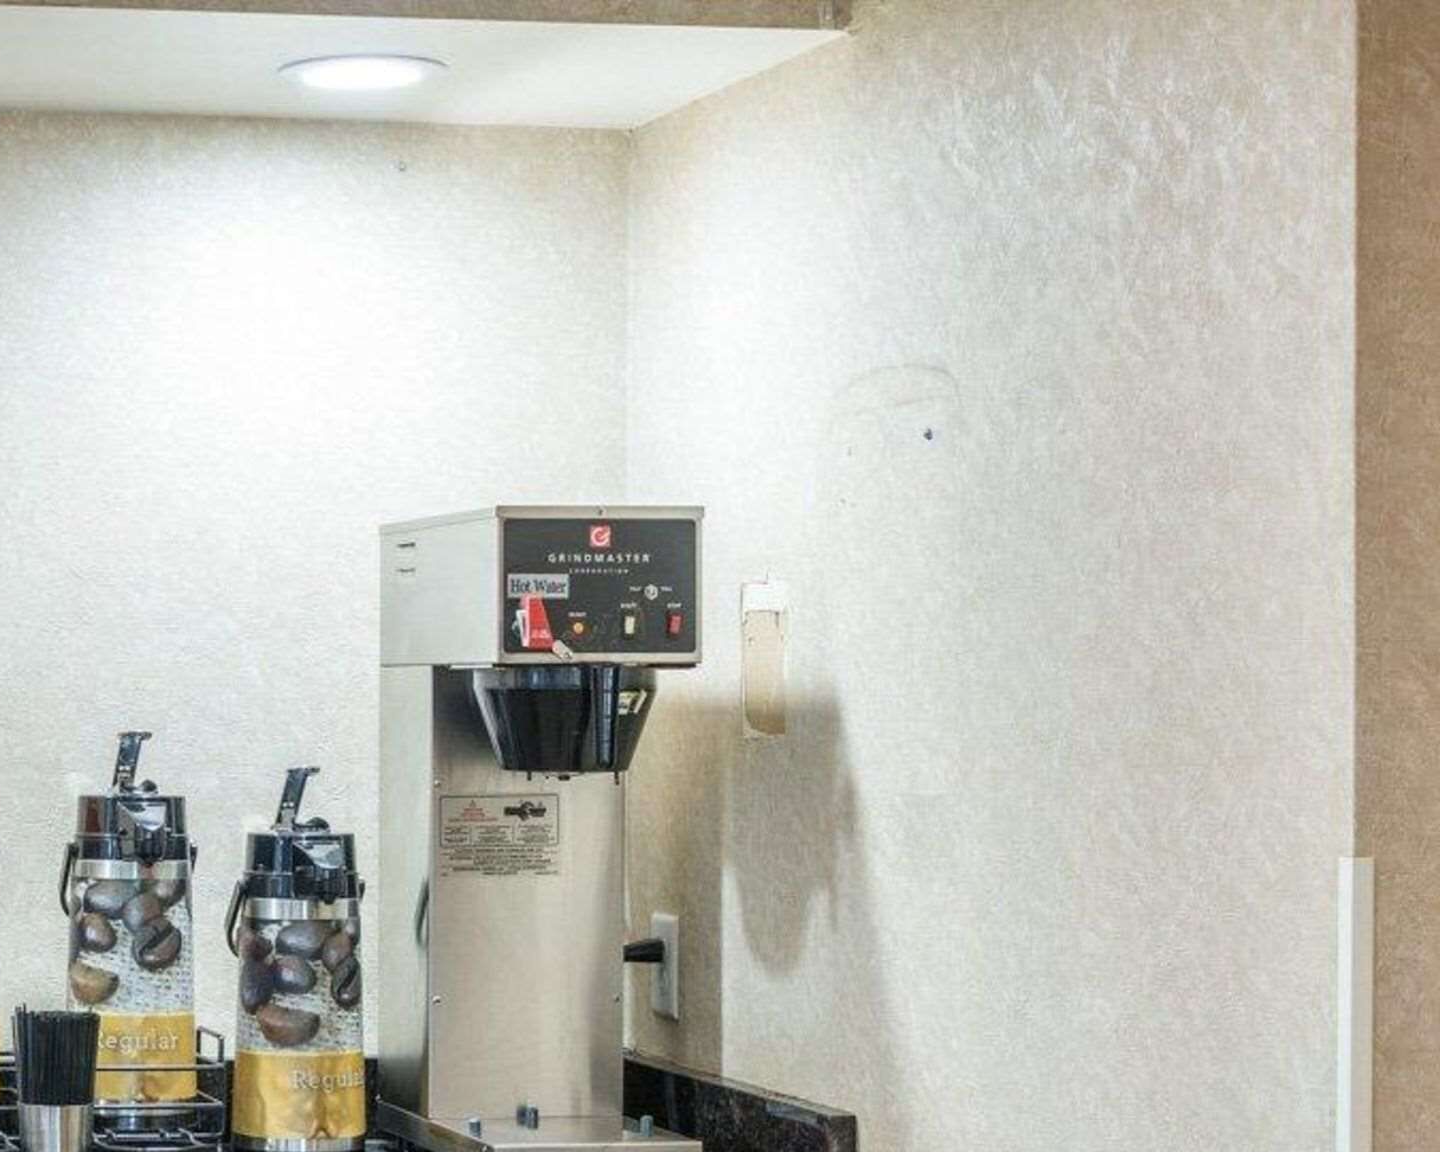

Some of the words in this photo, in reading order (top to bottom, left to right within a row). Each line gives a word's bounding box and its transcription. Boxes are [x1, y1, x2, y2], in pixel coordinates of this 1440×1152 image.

[547, 553, 650, 563] GRINDMASTER
[511, 579, 532, 593] Hot
[533, 578, 567, 594] Water
[292, 1068, 365, 1093] Regula
